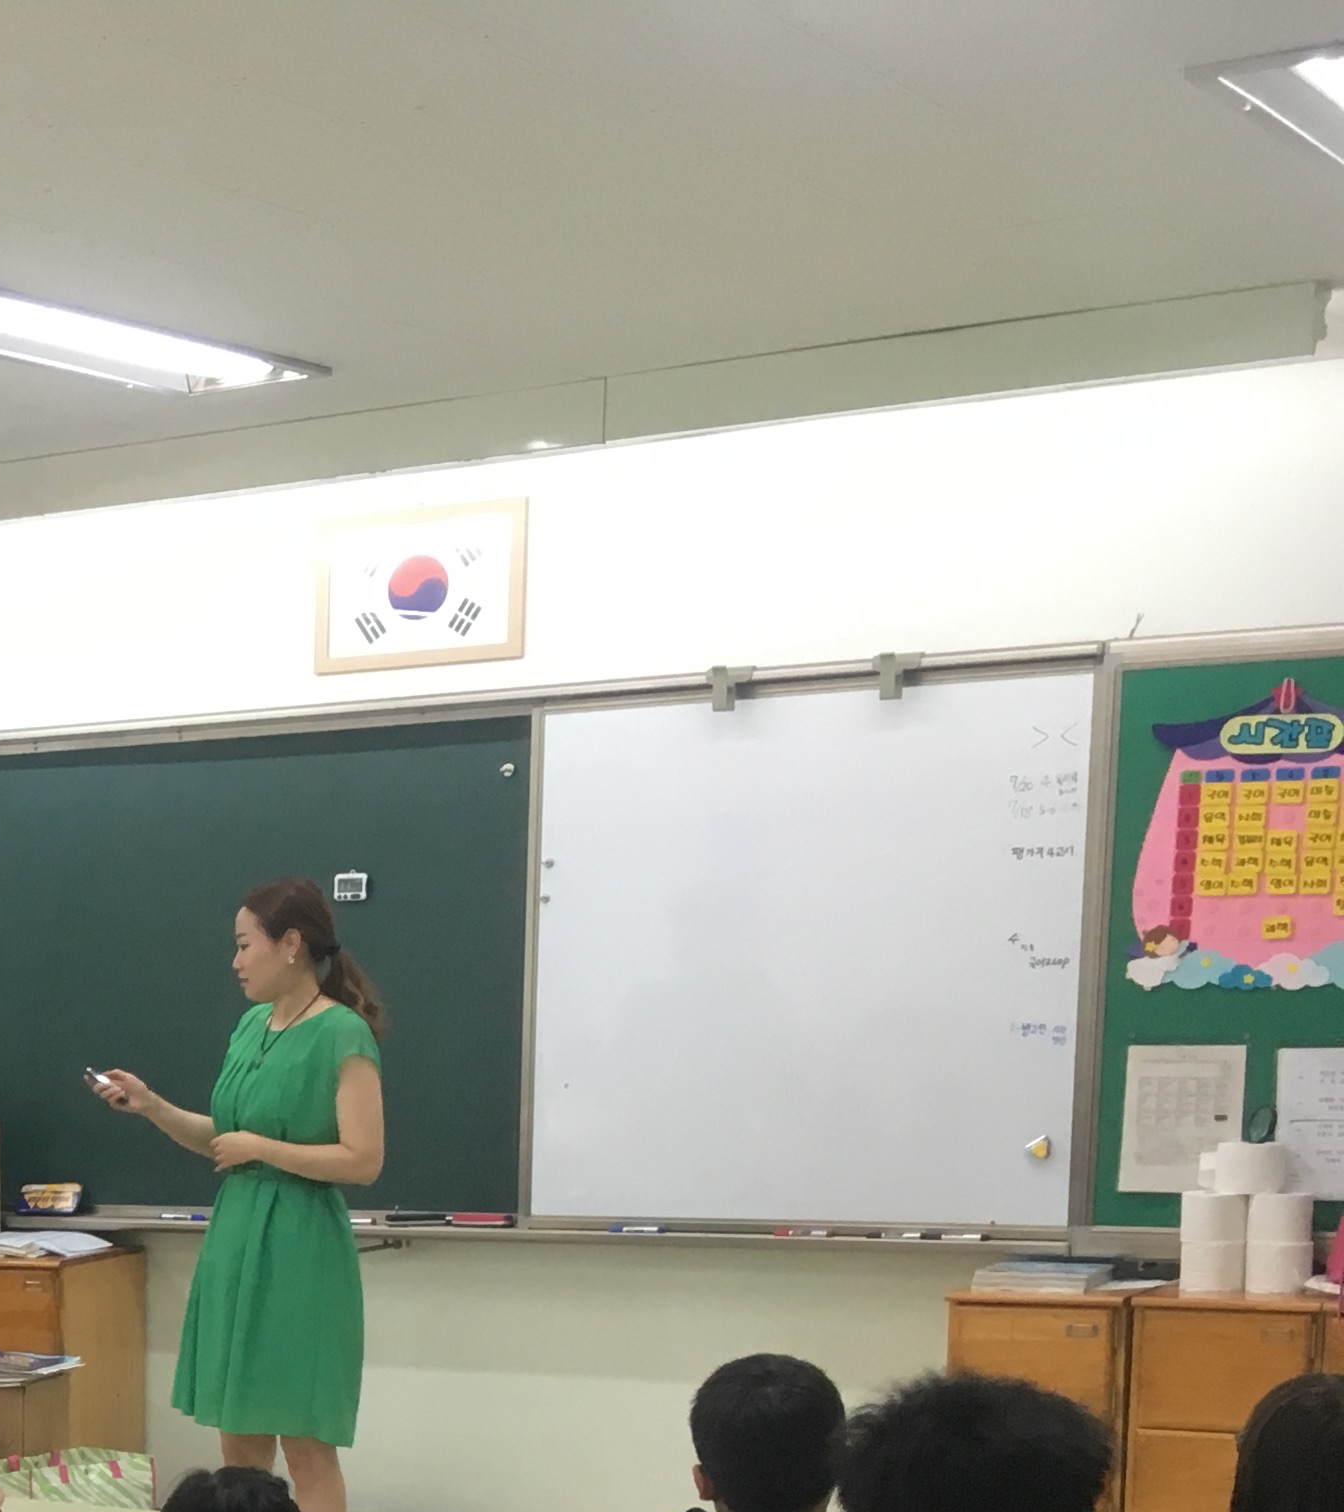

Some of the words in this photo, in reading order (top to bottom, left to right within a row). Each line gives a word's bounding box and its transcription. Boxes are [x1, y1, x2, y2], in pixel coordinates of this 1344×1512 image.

[1228, 717, 1336, 749] 시간표
[1206, 788, 1229, 800] 국어
[1242, 788, 1265, 800] 국어
[1277, 787, 1300, 799] 국어
